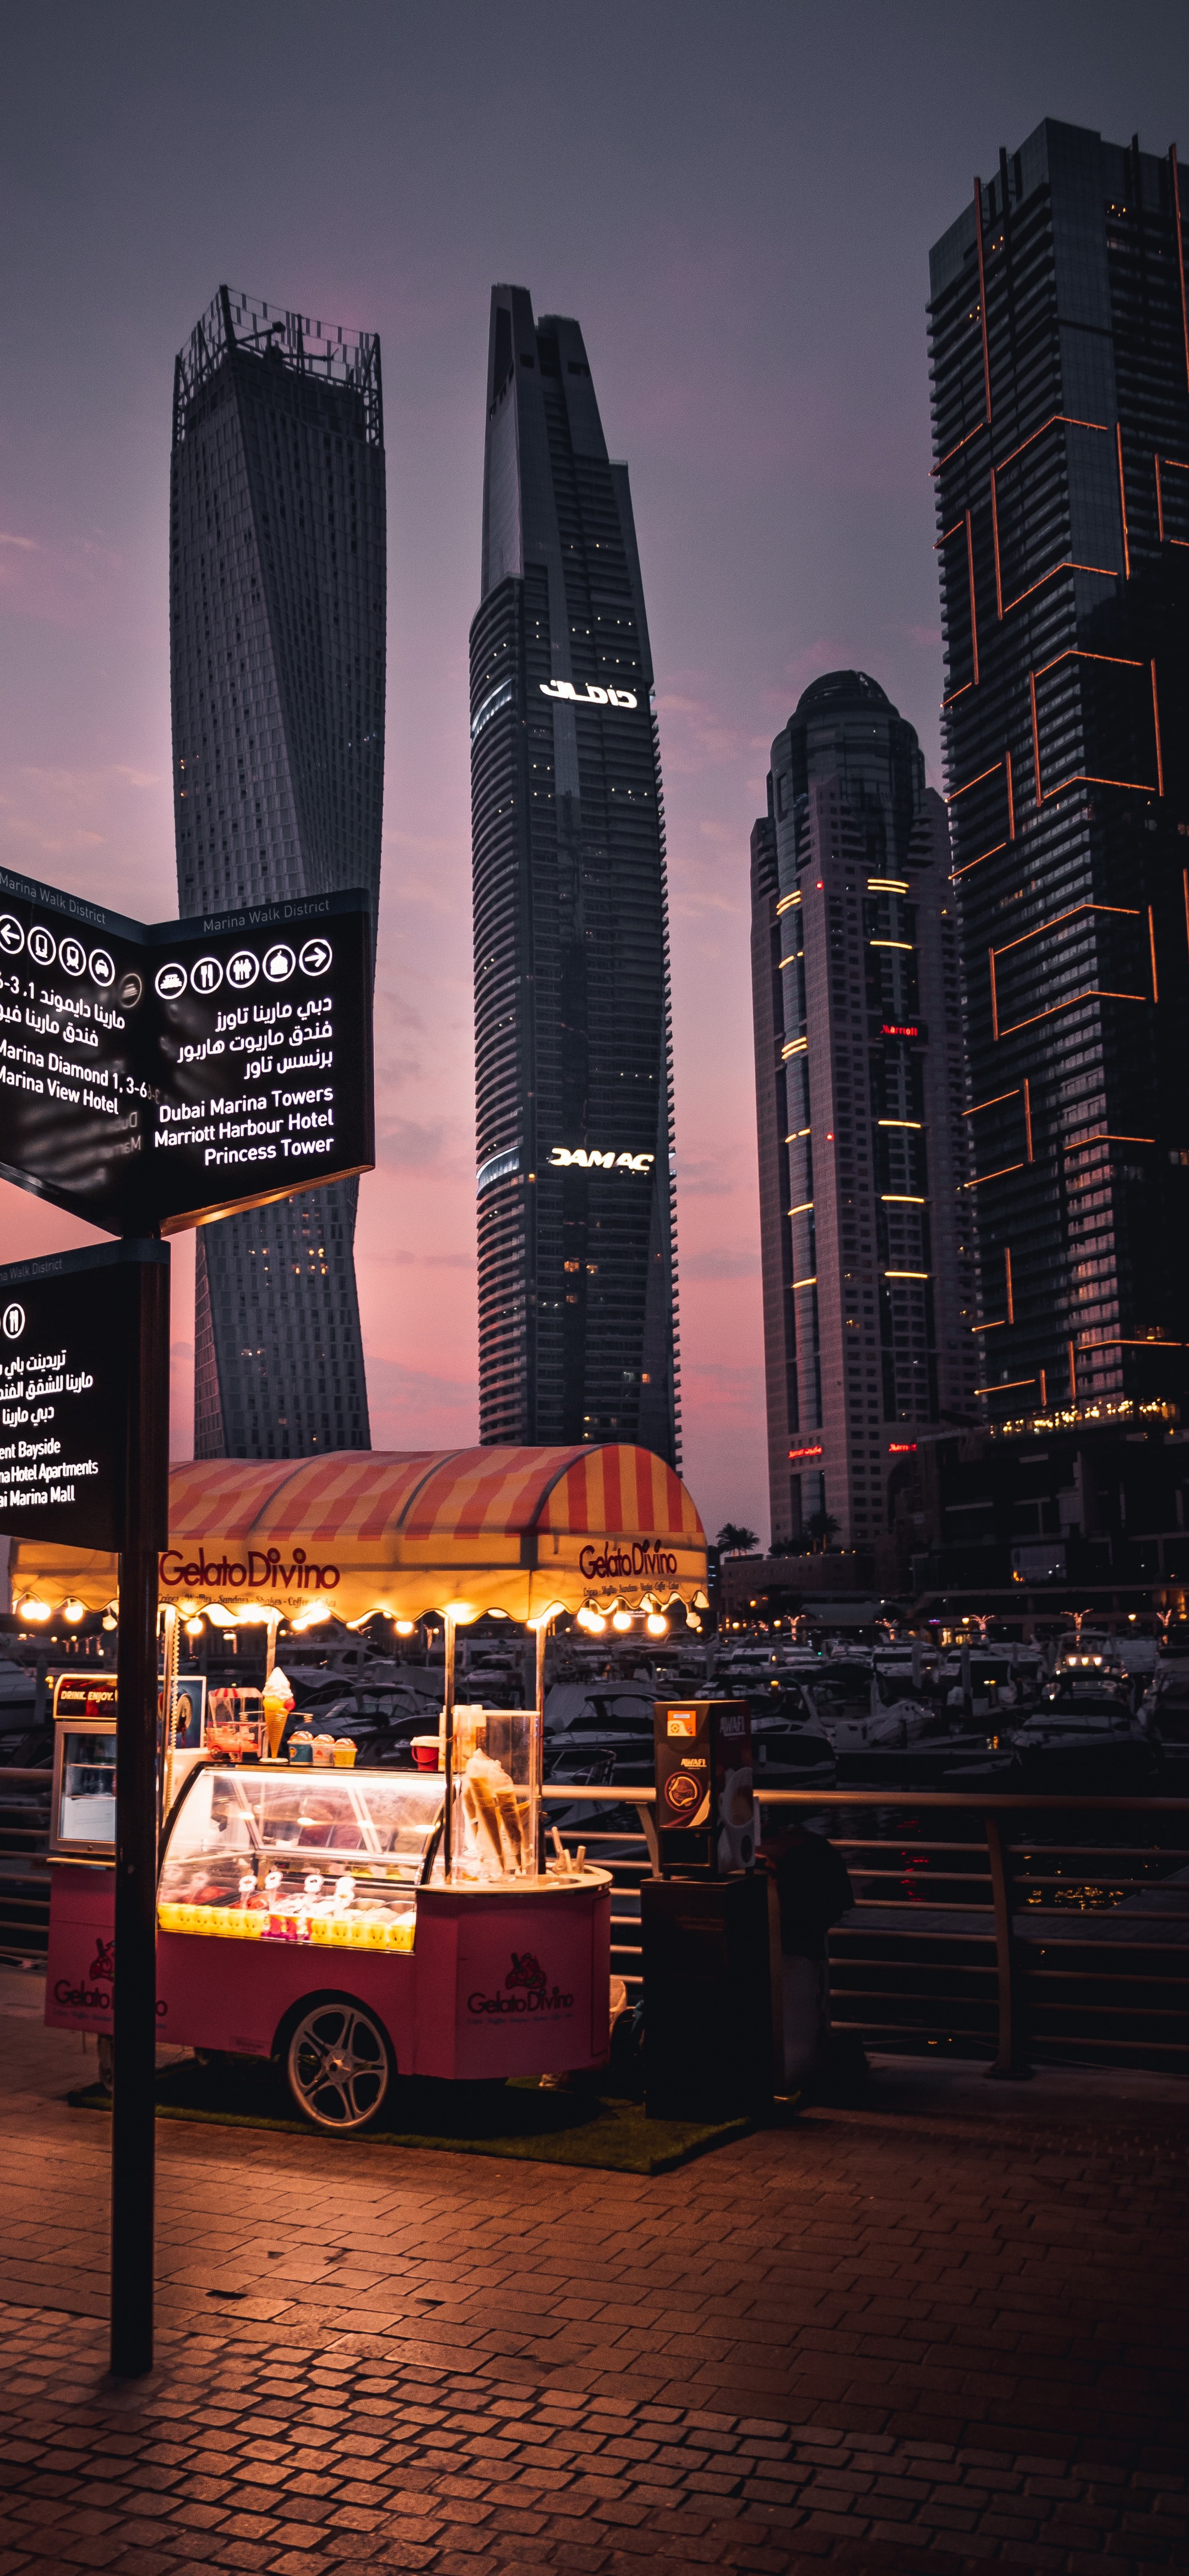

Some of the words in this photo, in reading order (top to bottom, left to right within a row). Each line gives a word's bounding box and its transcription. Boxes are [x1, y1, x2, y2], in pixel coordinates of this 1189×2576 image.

[0, 872, 37, 898] Marina
[40, 887, 67, 909] Walk
[69, 899, 106, 925] District
[204, 916, 246, 932] Marina
[249, 908, 280, 924] Walk
[284, 899, 330, 918] District
[40, 989, 91, 1018] دايموند
[94, 1003, 126, 1029] مارينا
[253, 1002, 292, 1024] مارينا
[297, 997, 332, 1021] دبي
[25, 1007, 59, 1034] مارينا
[215, 1007, 249, 1033] تاورز
[880, 1024, 918, 1036] Marriott
[63, 1022, 99, 1047] فندق
[229, 1029, 284, 1054] ماريوت
[288, 1020, 332, 1046] فندق
[177, 1038, 225, 1063] هاربور
[276, 1049, 333, 1074] برنسس
[0, 1039, 44, 1068] Marina
[48, 1052, 108, 1087] Diamond
[126, 1077, 148, 1098] 3-6
[243, 1056, 273, 1080] تاور
[47, 1078, 80, 1103] View
[83, 1088, 119, 1115] Hotel
[159, 1100, 205, 1123] Dubai
[210, 1095, 267, 1116] Marina
[271, 1087, 334, 1107] Towers
[155, 1125, 216, 1148] Marriott
[219, 1118, 284, 1139] Harbour
[288, 1108, 334, 1131] Hotel
[205, 1145, 277, 1166] Princess
[280, 1138, 335, 1156] Tower
[550, 1147, 655, 1171] DAMAC
[10, 1264, 30, 1278] Walk
[32, 1258, 62, 1275] District
[4, 1356, 24, 1380] باي
[26, 1349, 67, 1372] تريدينت
[25, 1374, 64, 1400] للشقق
[66, 1371, 94, 1393] مارينا
[2, 1406, 29, 1428] مارينا
[30, 1406, 54, 1427] دبي
[18, 1437, 61, 1460] Bayside
[10, 1464, 38, 1482] Hotel
[38, 1459, 99, 1483] Apartments
[9, 1488, 48, 1507] Marina
[50, 1485, 75, 1503] Mall
[88, 1691, 114, 1703] ENJOY.
[680, 1758, 707, 1767] AWAFI
